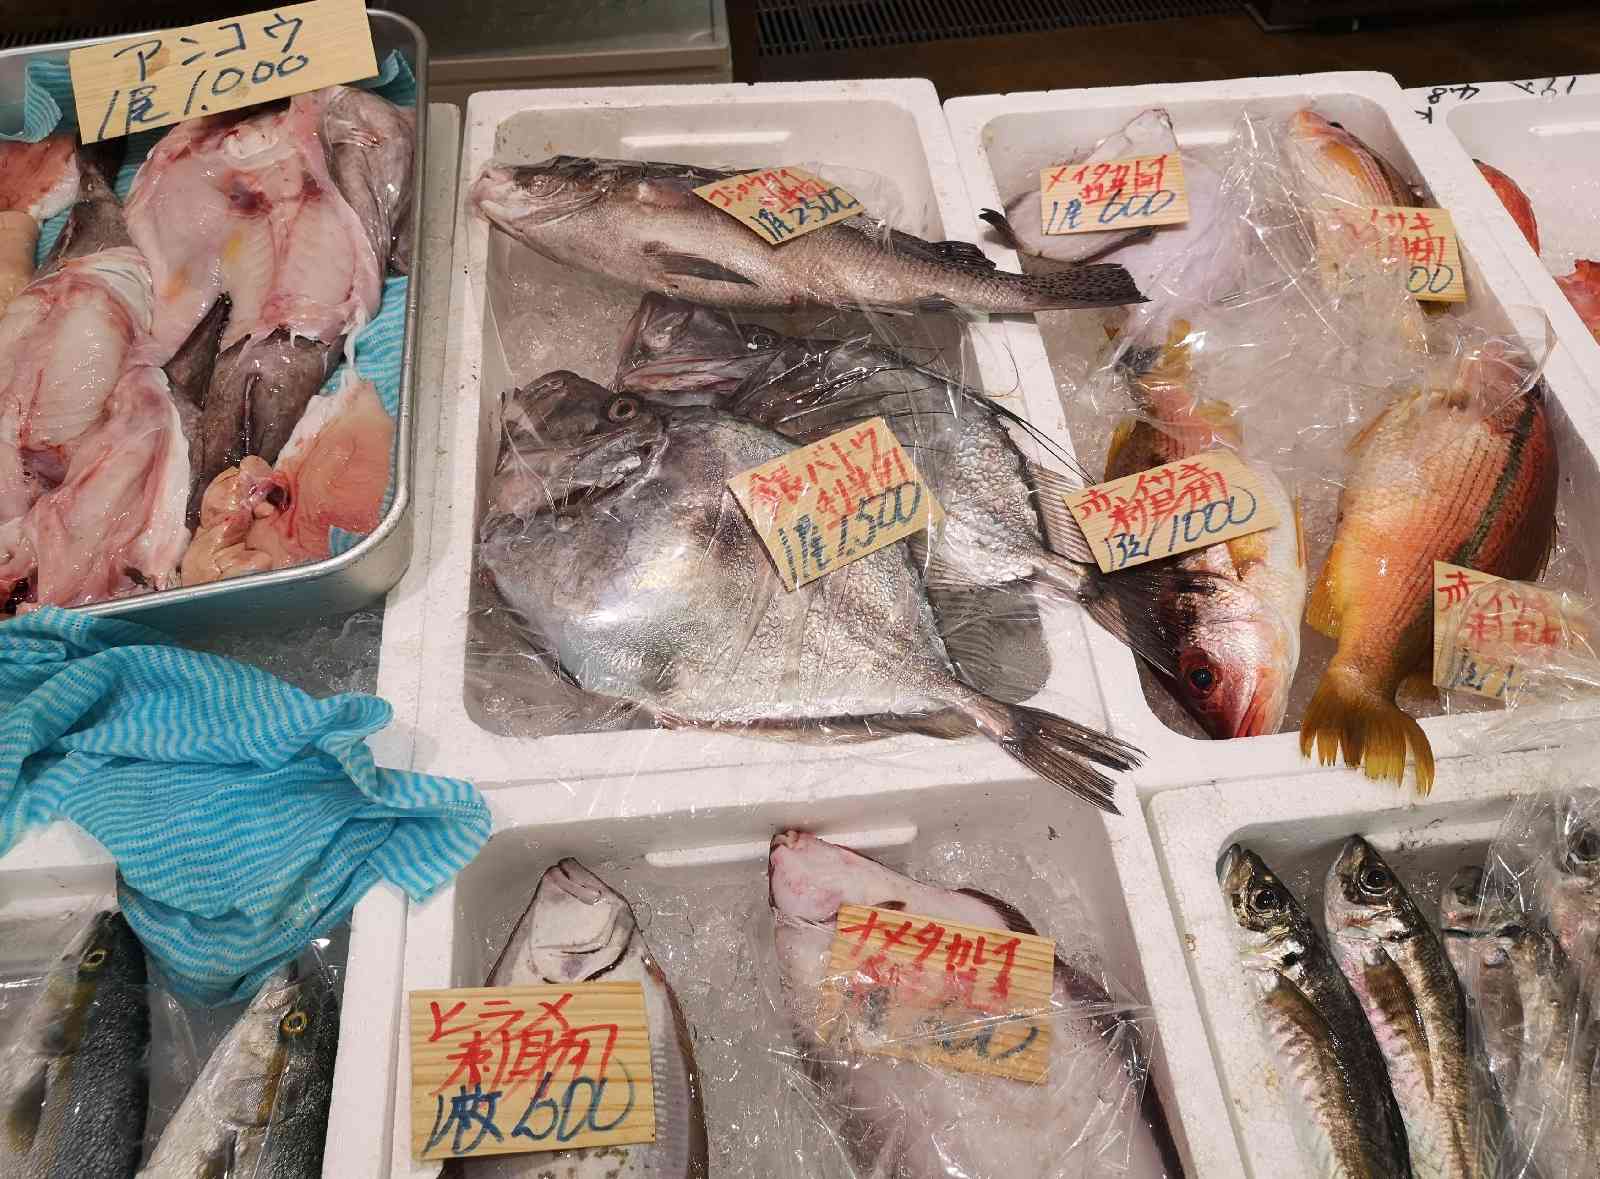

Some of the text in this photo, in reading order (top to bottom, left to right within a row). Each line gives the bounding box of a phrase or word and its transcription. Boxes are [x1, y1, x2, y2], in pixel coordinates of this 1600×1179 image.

[113, 13, 304, 82] アンコウ
[1098, 188, 1177, 225] 600
[427, 992, 574, 1043] ヒラメ
[511, 1057, 636, 1143] 600
